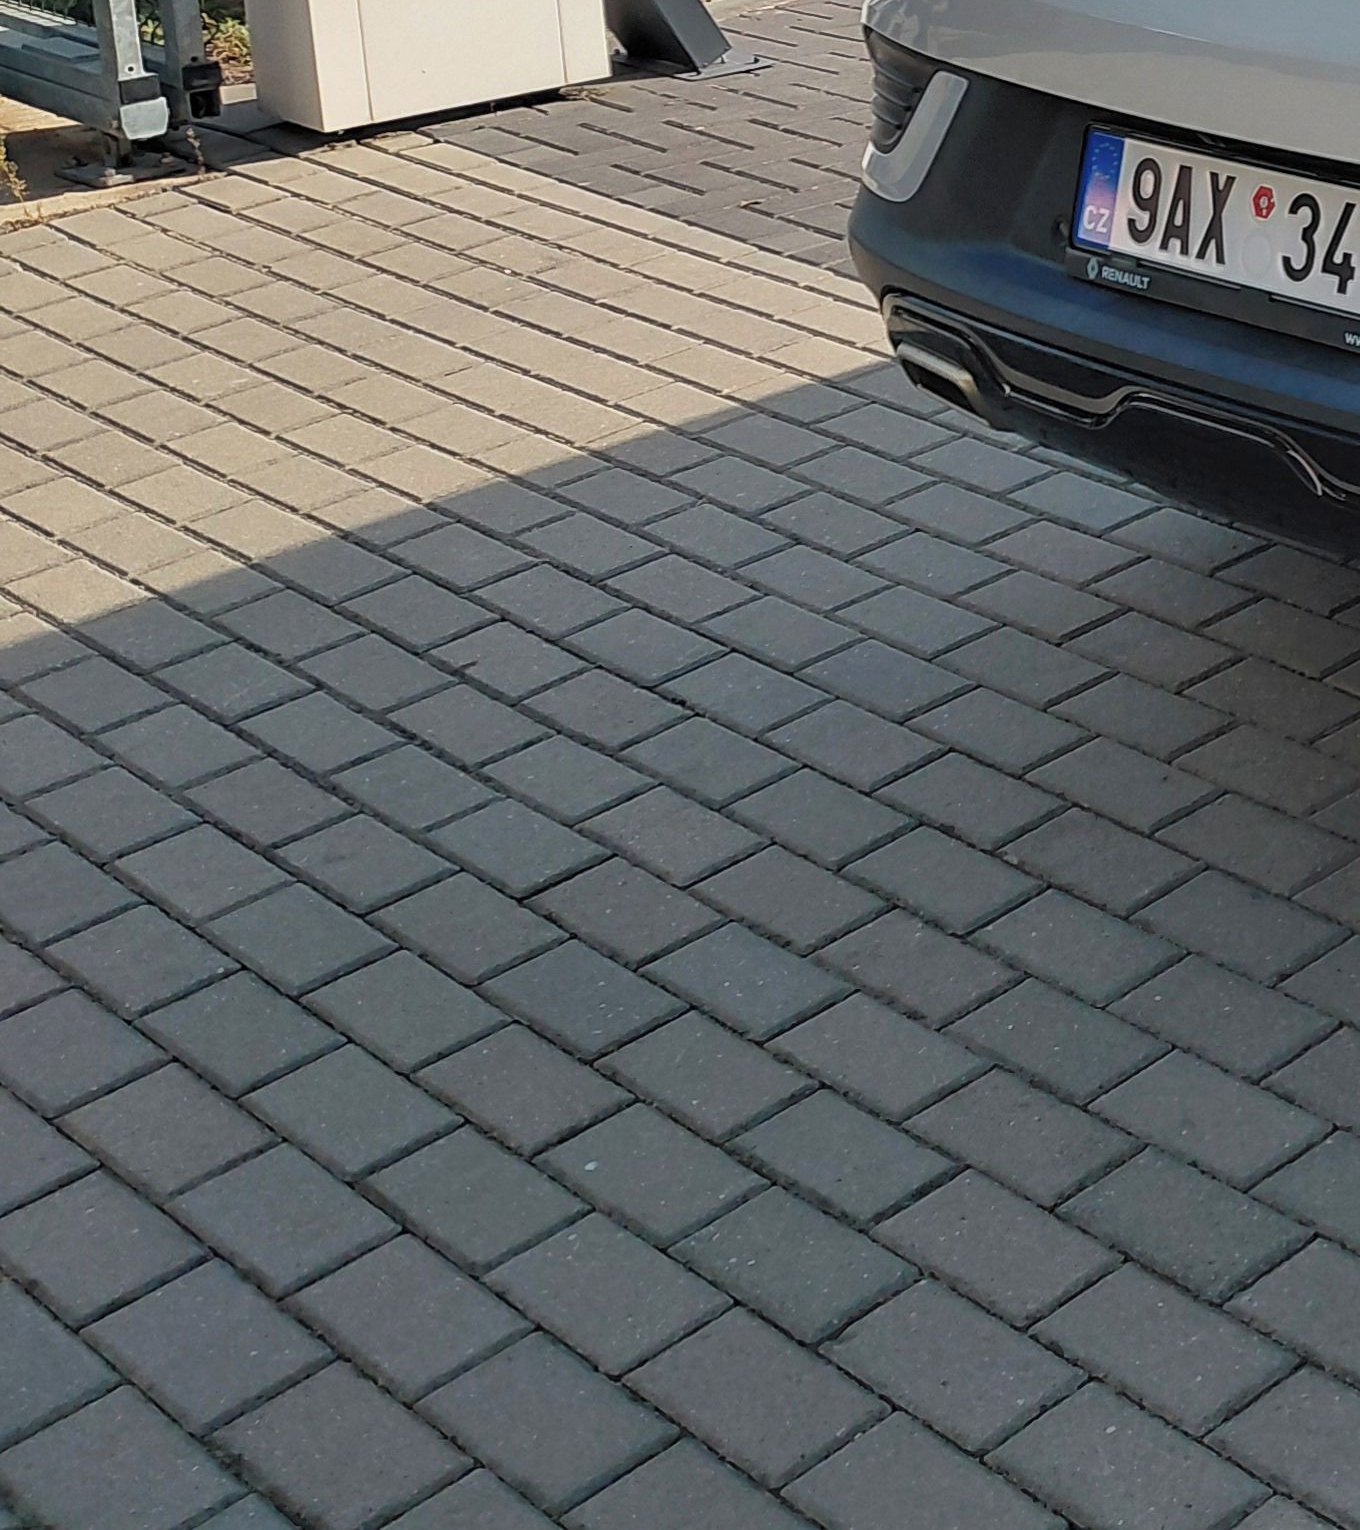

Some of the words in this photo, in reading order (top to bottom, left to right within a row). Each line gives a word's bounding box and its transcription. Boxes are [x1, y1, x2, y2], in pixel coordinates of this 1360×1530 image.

[1082, 205, 1112, 233] CZ
[1127, 157, 1237, 265] 9AX
[1101, 266, 1151, 290] RENAULT
